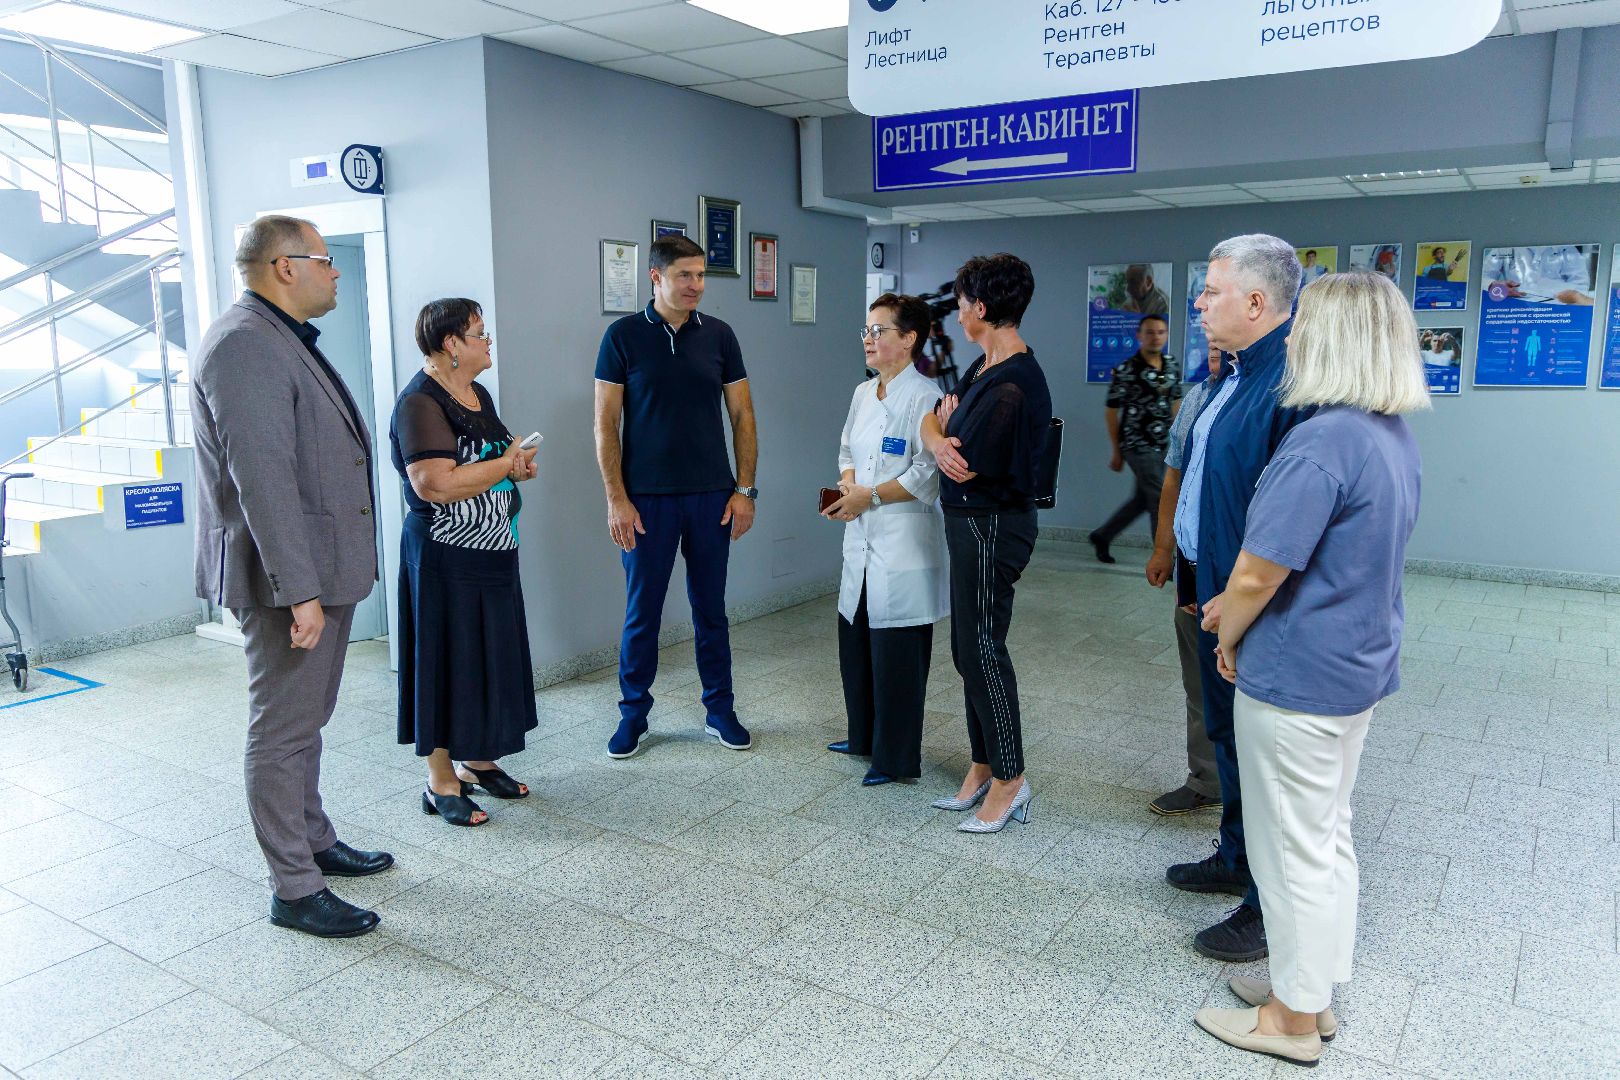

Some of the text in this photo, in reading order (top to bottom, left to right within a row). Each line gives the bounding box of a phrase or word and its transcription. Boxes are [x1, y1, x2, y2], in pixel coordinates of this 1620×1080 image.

[1045, 0, 1087, 20] Каб.
[865, 28, 912, 47] Лифт
[1044, 22, 1125, 44] Рентген
[1261, 15, 1380, 46] рецептов
[865, 46, 947, 69] Лестница
[1043, 43, 1155, 69] Терапевты
[881, 101, 1129, 156] РЕНТГЕН-КАБИНЕТ
[126, 485, 180, 496] КРЕСЛО-КОЛЯСКА
